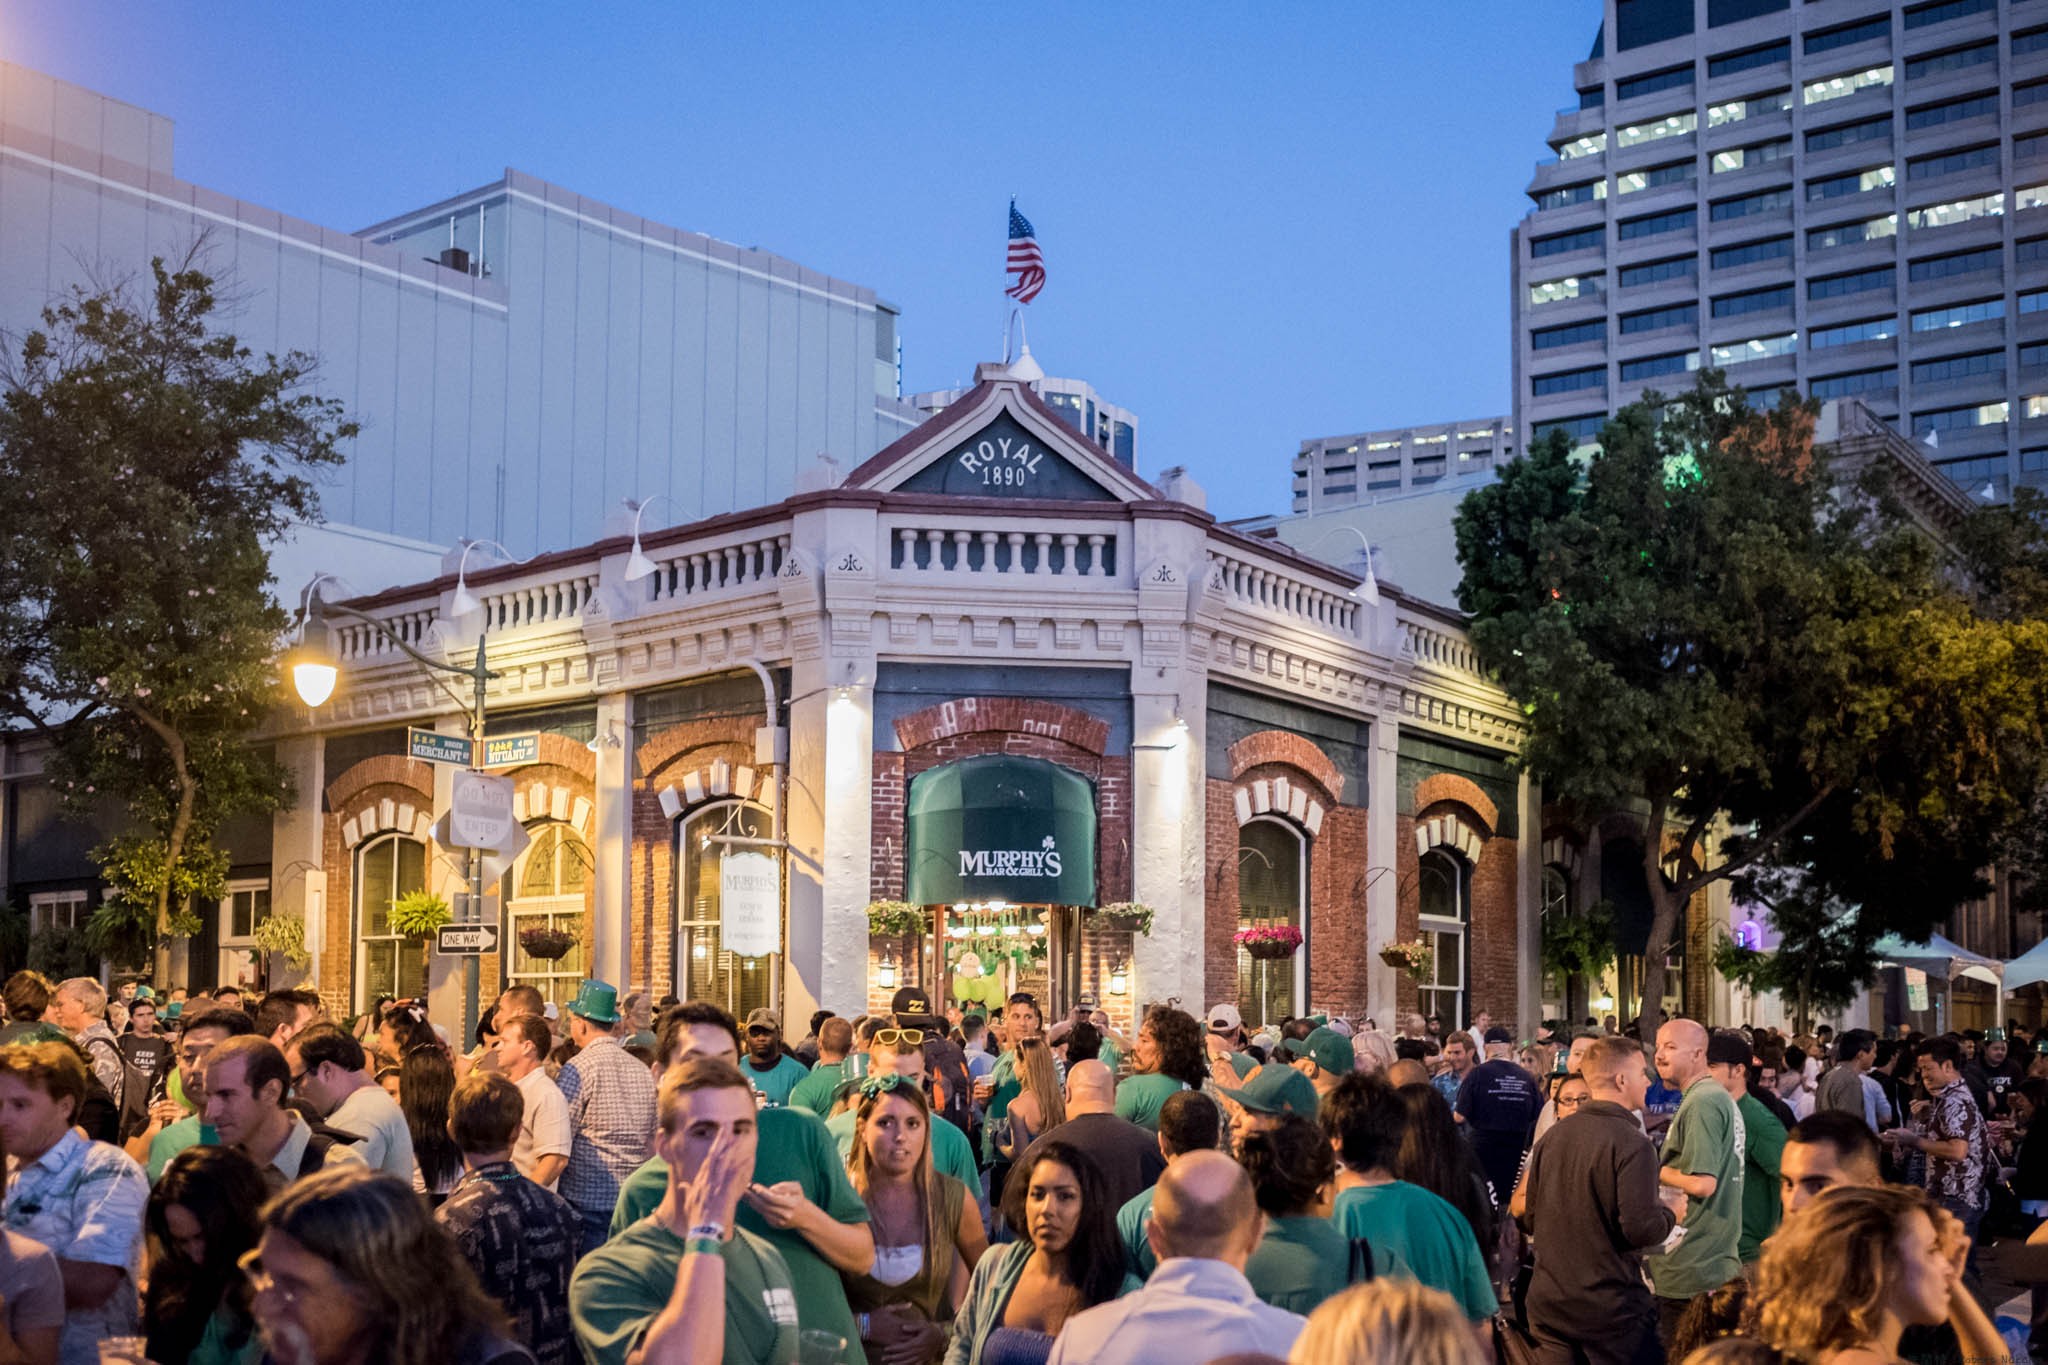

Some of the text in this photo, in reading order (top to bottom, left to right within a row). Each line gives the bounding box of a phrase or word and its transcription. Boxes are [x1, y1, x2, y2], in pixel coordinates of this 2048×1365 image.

[959, 438, 1043, 474] ROYAL
[982, 466, 1025, 487] 1890
[412, 744, 462, 761] MERCHANT
[464, 787, 504, 802] DO NOT
[464, 819, 498, 834] ENTER
[444, 933, 480, 945] ONE WAY
